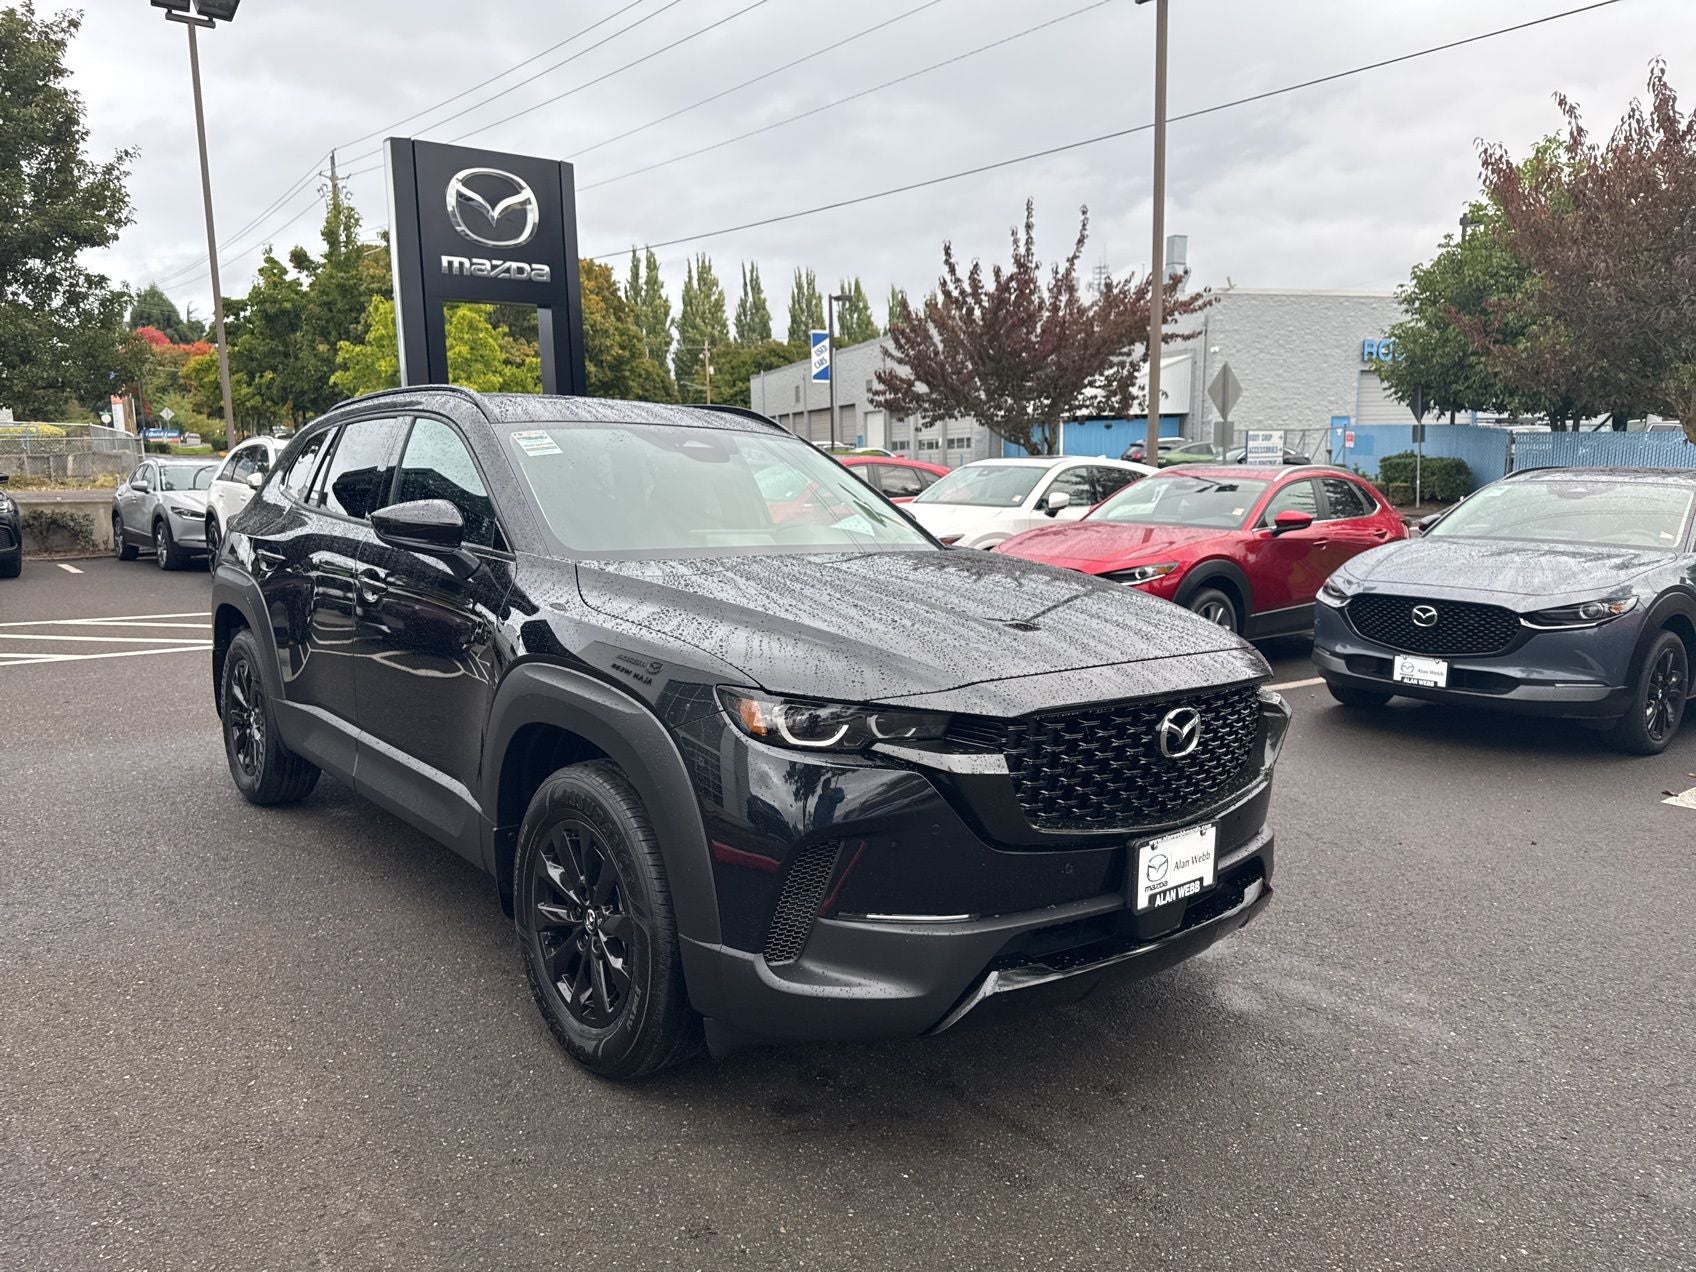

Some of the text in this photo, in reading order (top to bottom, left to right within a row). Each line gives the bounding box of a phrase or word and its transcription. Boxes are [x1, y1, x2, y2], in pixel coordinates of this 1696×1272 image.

[441, 255, 551, 283] mazda
[815, 345, 827, 356] USED
[814, 357, 827, 369] CARS
[1248, 446, 1278, 454] ACCESSORIES
[1174, 850, 1210, 871] Alan Webb
[1145, 881, 1168, 892] mazda
[1155, 881, 1200, 907] ALAN WEBB
